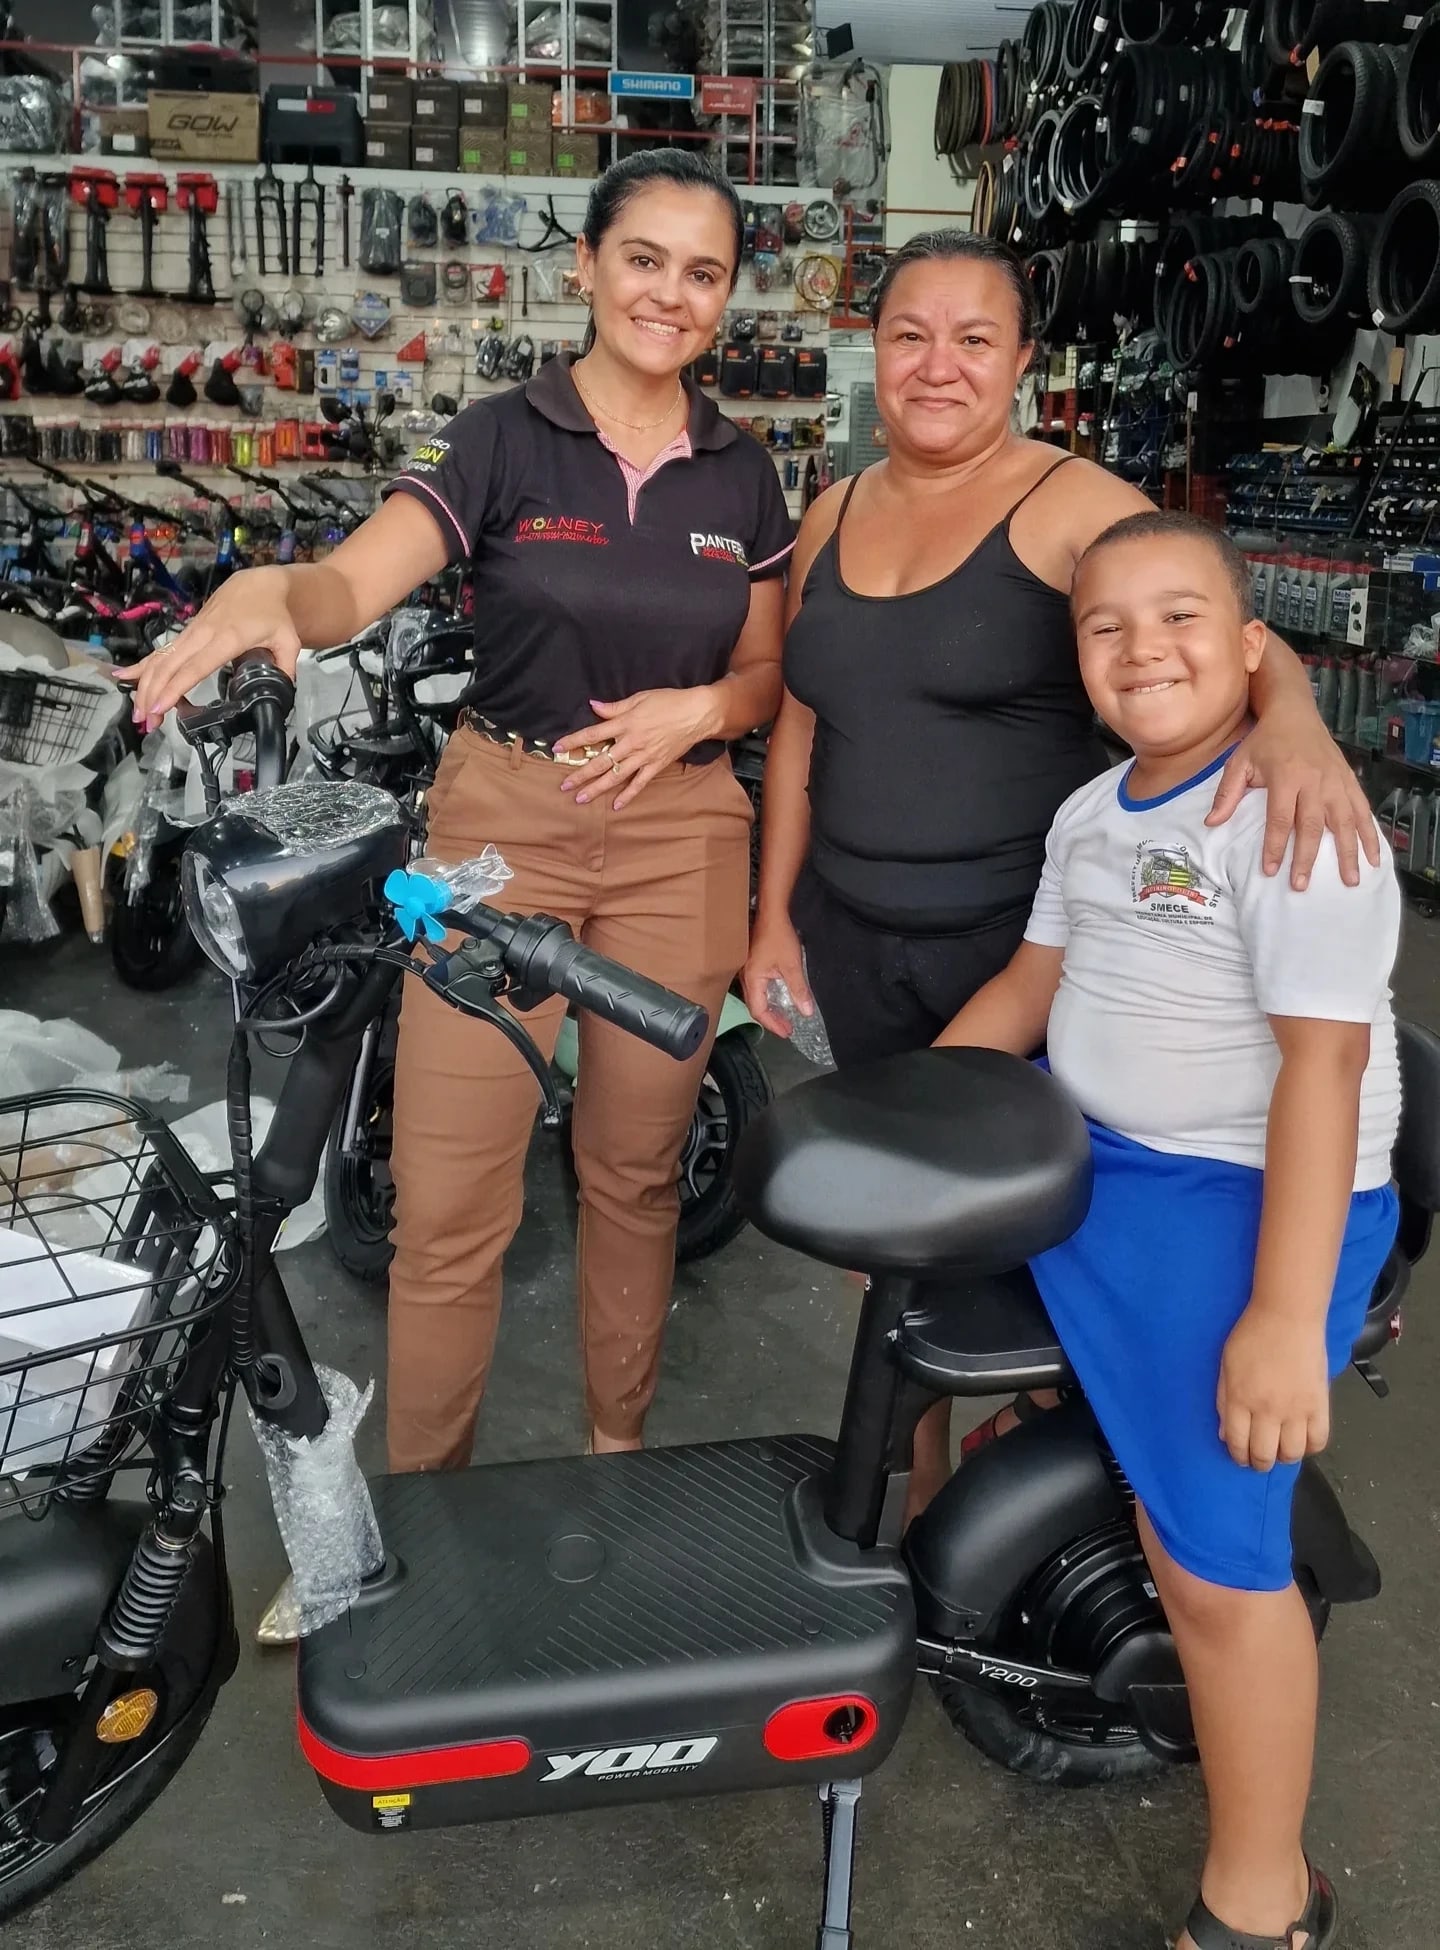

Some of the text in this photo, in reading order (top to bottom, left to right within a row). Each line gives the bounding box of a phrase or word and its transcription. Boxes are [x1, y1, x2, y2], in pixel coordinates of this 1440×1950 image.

[621, 78, 682, 92] SHIMANO
[167, 114, 239, 132] GOW
[517, 516, 604, 534] WOLNEY
[1149, 902, 1190, 914] SMECE
[979, 1662, 1038, 1688] Y200
[539, 1736, 718, 1782] YOO
[598, 1764, 699, 1781] POWER MOBILITY
